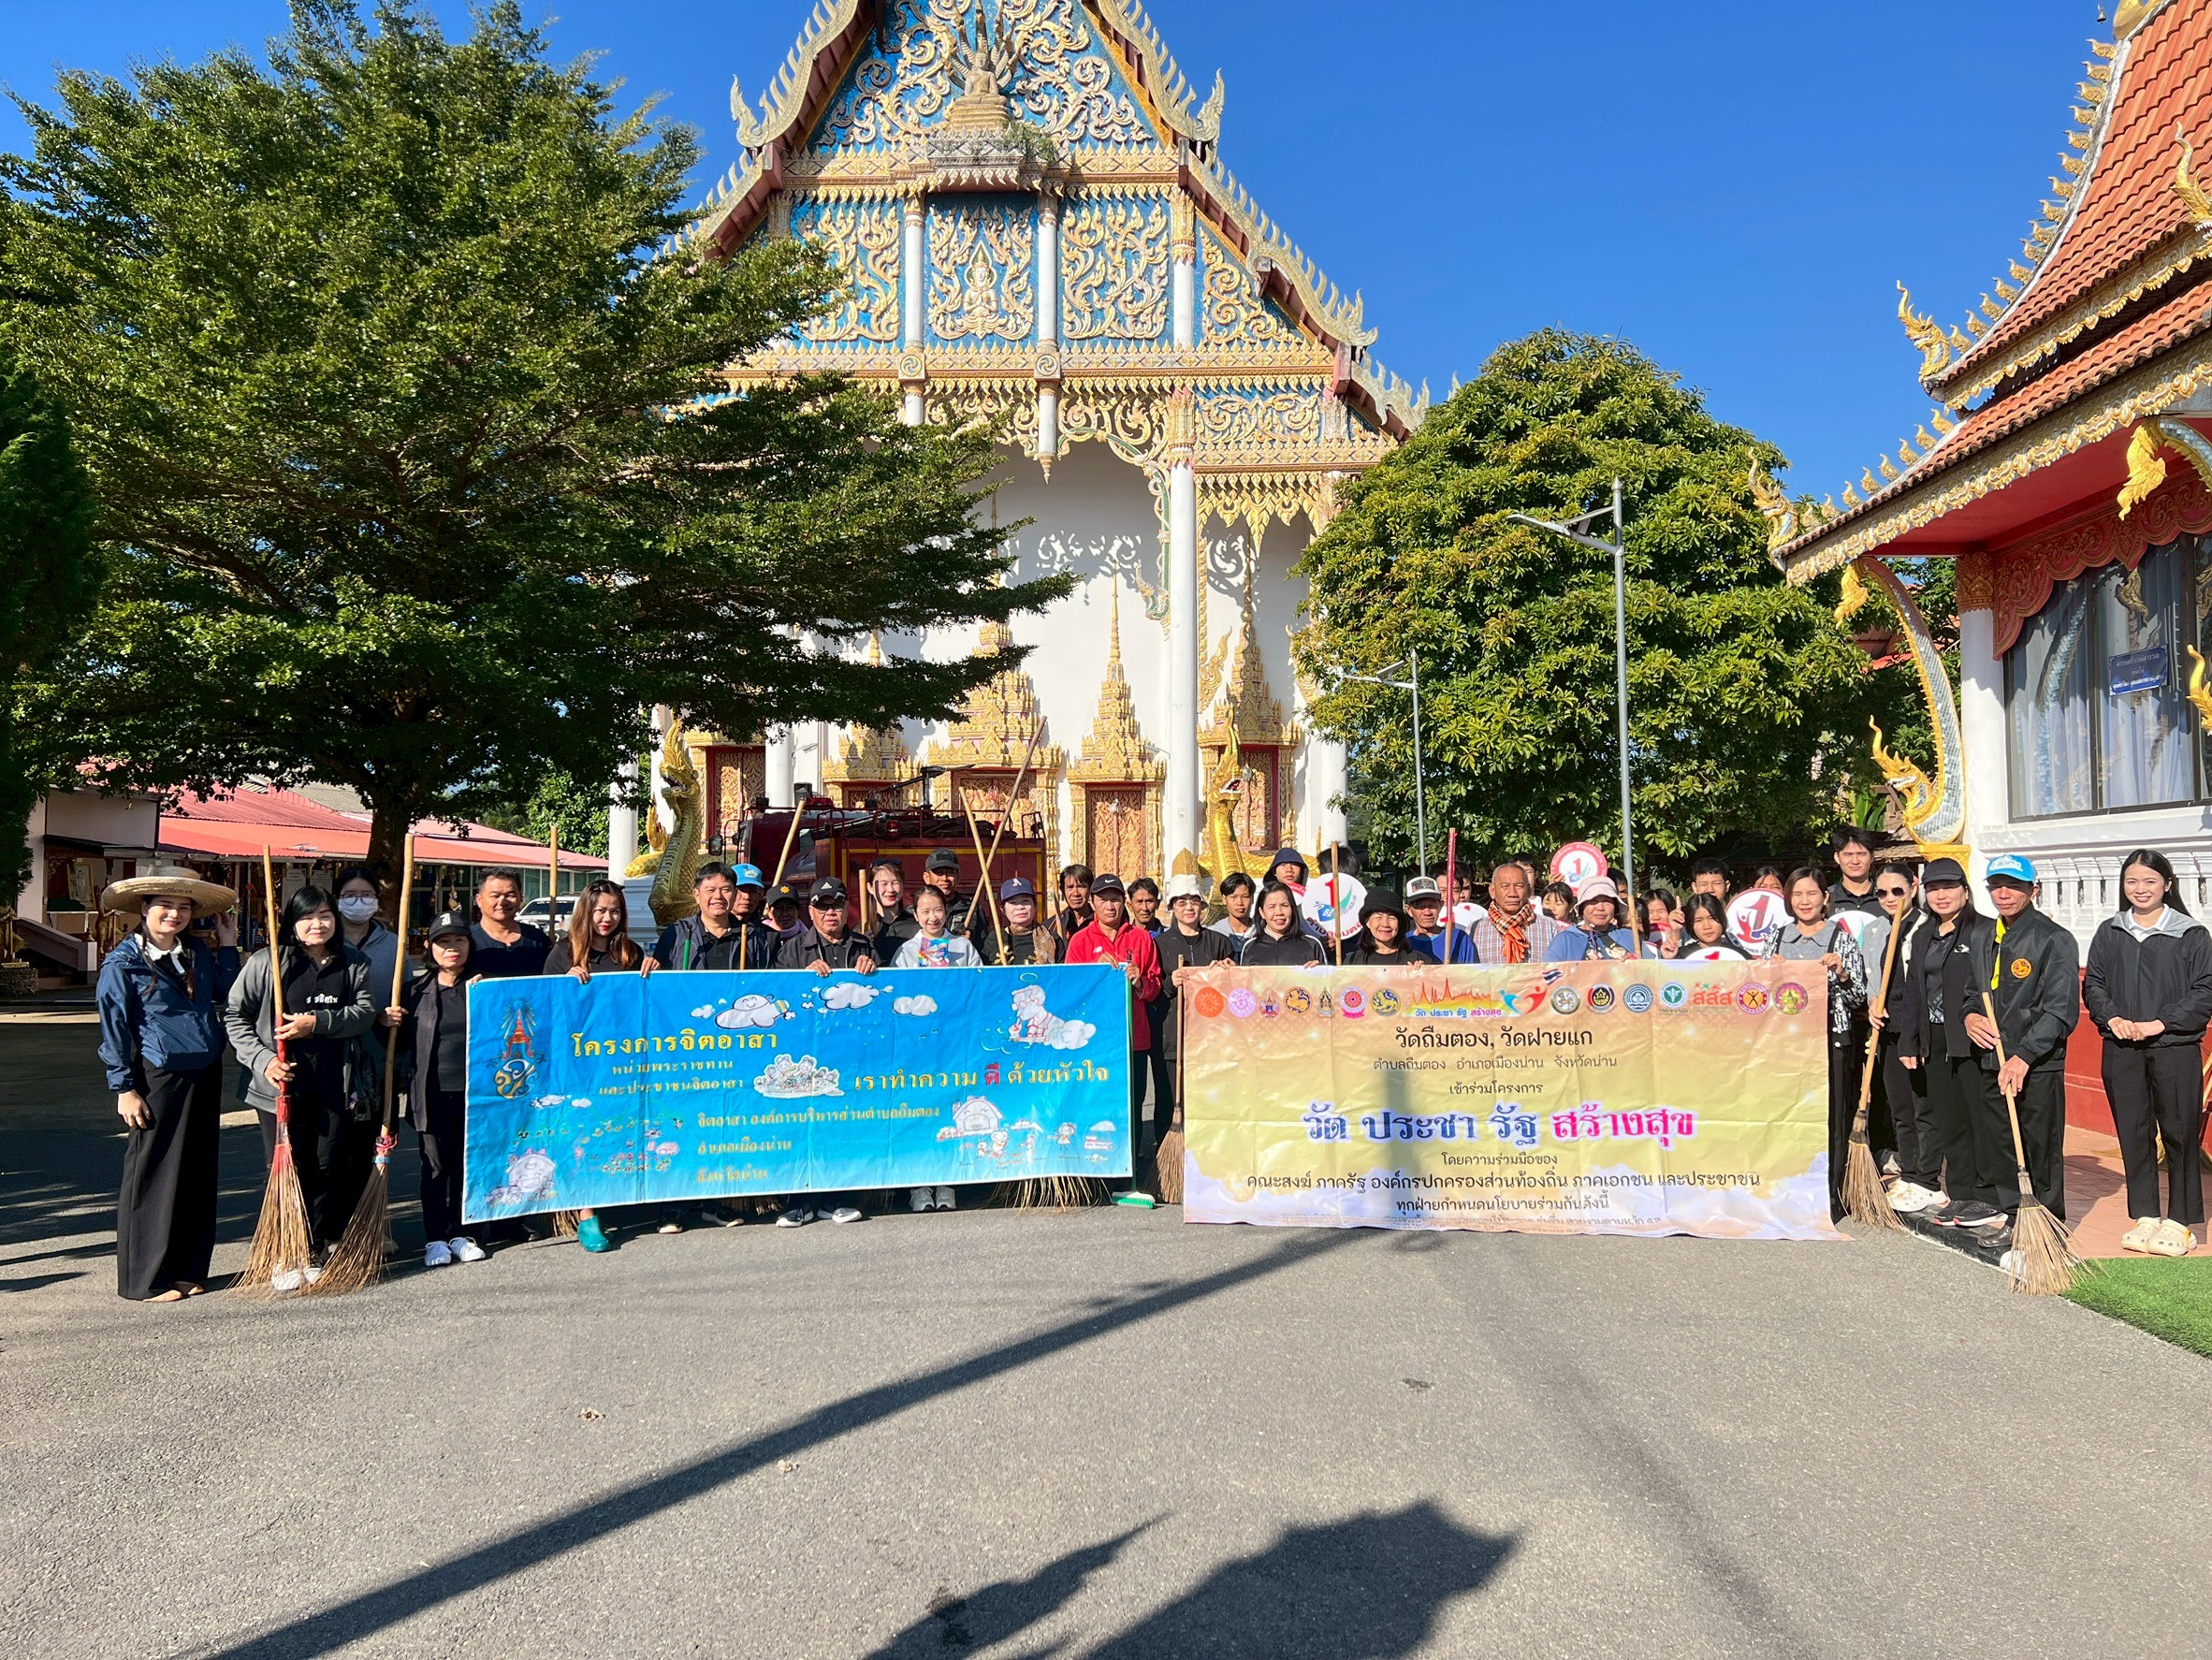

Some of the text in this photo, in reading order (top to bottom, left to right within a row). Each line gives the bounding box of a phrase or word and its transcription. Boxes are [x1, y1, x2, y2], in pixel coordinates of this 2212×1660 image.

[1744, 894, 1770, 931] 1
[1430, 1009, 1453, 1017] ประชา
[570, 1027, 778, 1058] โครงการจิตอาสา
[1500, 1026, 1594, 1047] วัดฝายแก
[611, 1057, 734, 1075] หน่วยพระราชทาน
[1373, 1054, 1617, 1070] ตำบลถืมตอง อำเภอเมืองน่าน จังหวัดน่าน
[854, 1059, 1110, 1090] เราทำความ ดี ด้วยหัวใจ
[599, 1078, 744, 1096] และประชาชนจิตอาสา
[1449, 1081, 1544, 1096] เข้าร่วมโครงการ
[696, 1112, 748, 1129] จิตอาสา
[1304, 1101, 1695, 1147] วัด ประชา รัฐ สร้างสุข
[696, 1136, 793, 1156] อำเภอเมืองน่าน
[1442, 1152, 1558, 1167] โดยความร่วมมือของ
[1247, 1167, 1761, 1194] คณะสงฆ์ ภาครัฐ องค์กรปกครองส่วนท้องถิ่น ภาคเอกชน และประชาชน
[1396, 1189, 1609, 1216] ทุกฝ่ายกำหนดนโยบายร่วมกันดังนี้
